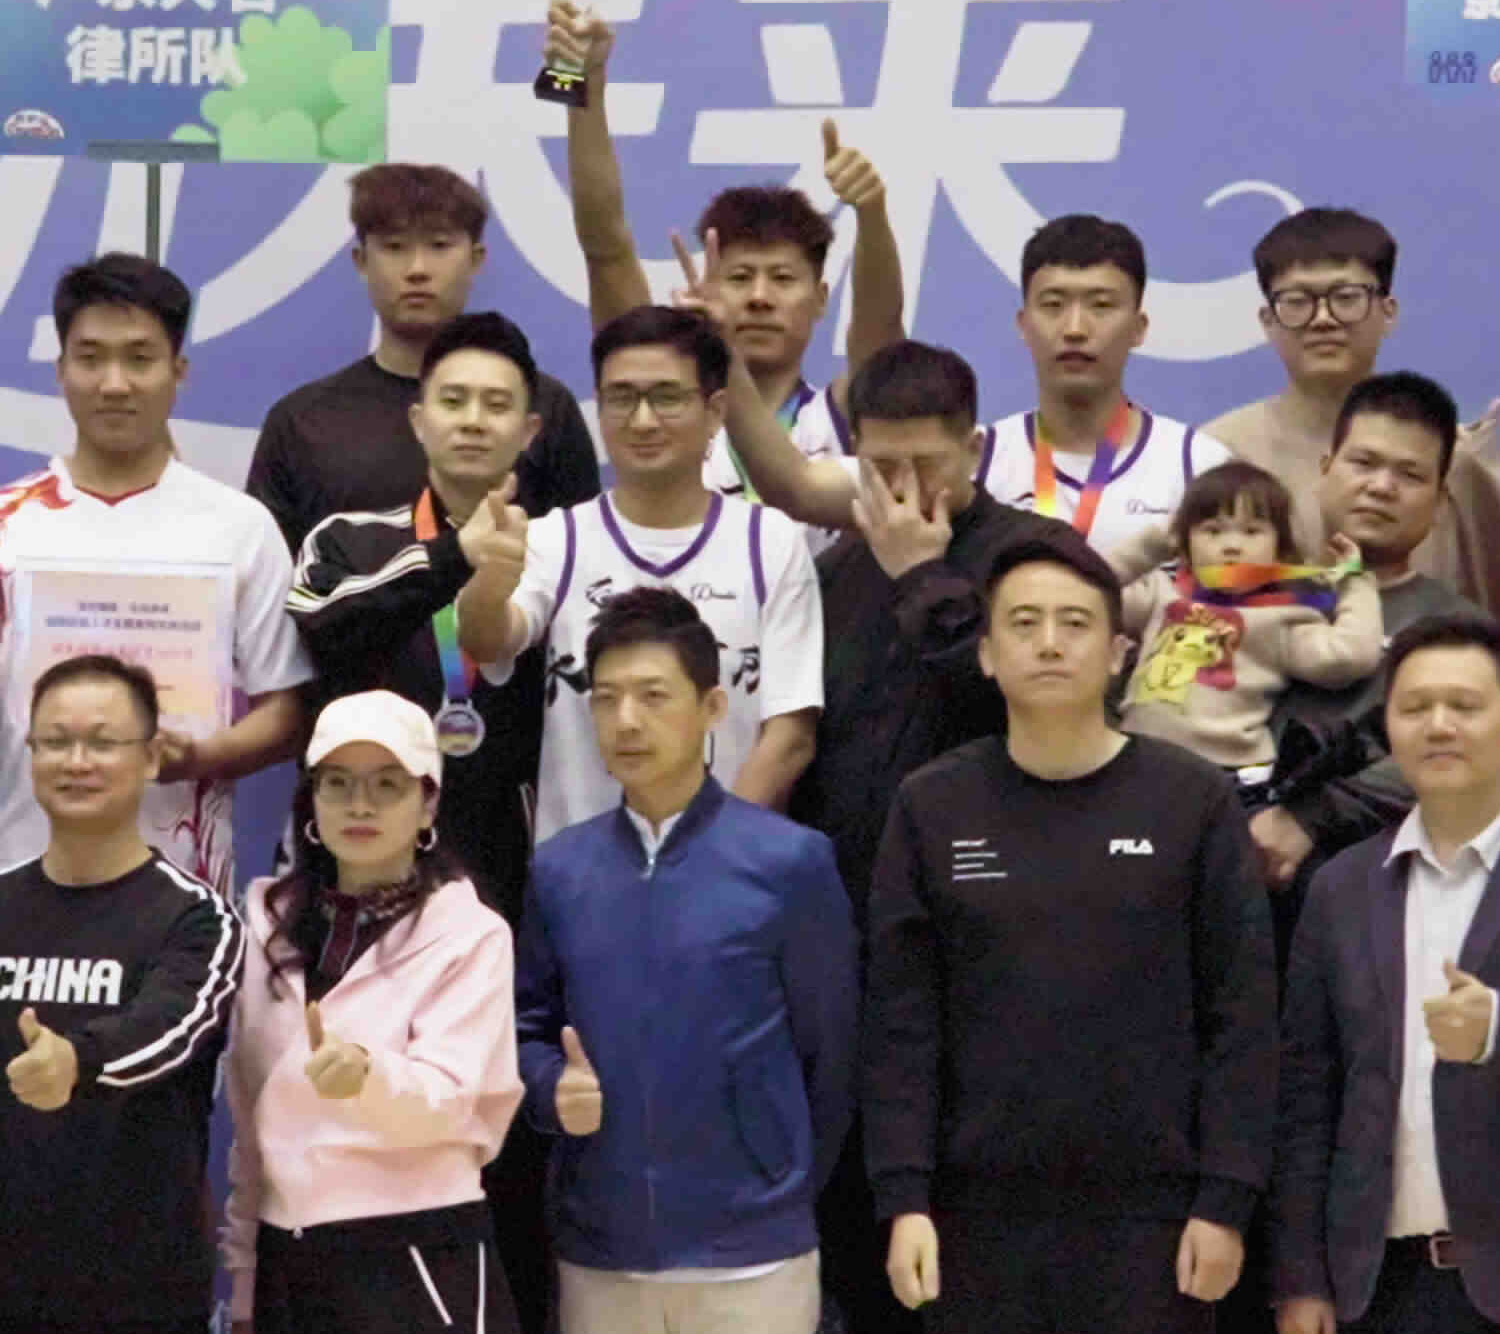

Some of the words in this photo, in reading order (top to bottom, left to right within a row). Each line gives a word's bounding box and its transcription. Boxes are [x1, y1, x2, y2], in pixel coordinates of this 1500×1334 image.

[66, 25, 249, 84] 律所队
[1108, 838, 1154, 855] FILA
